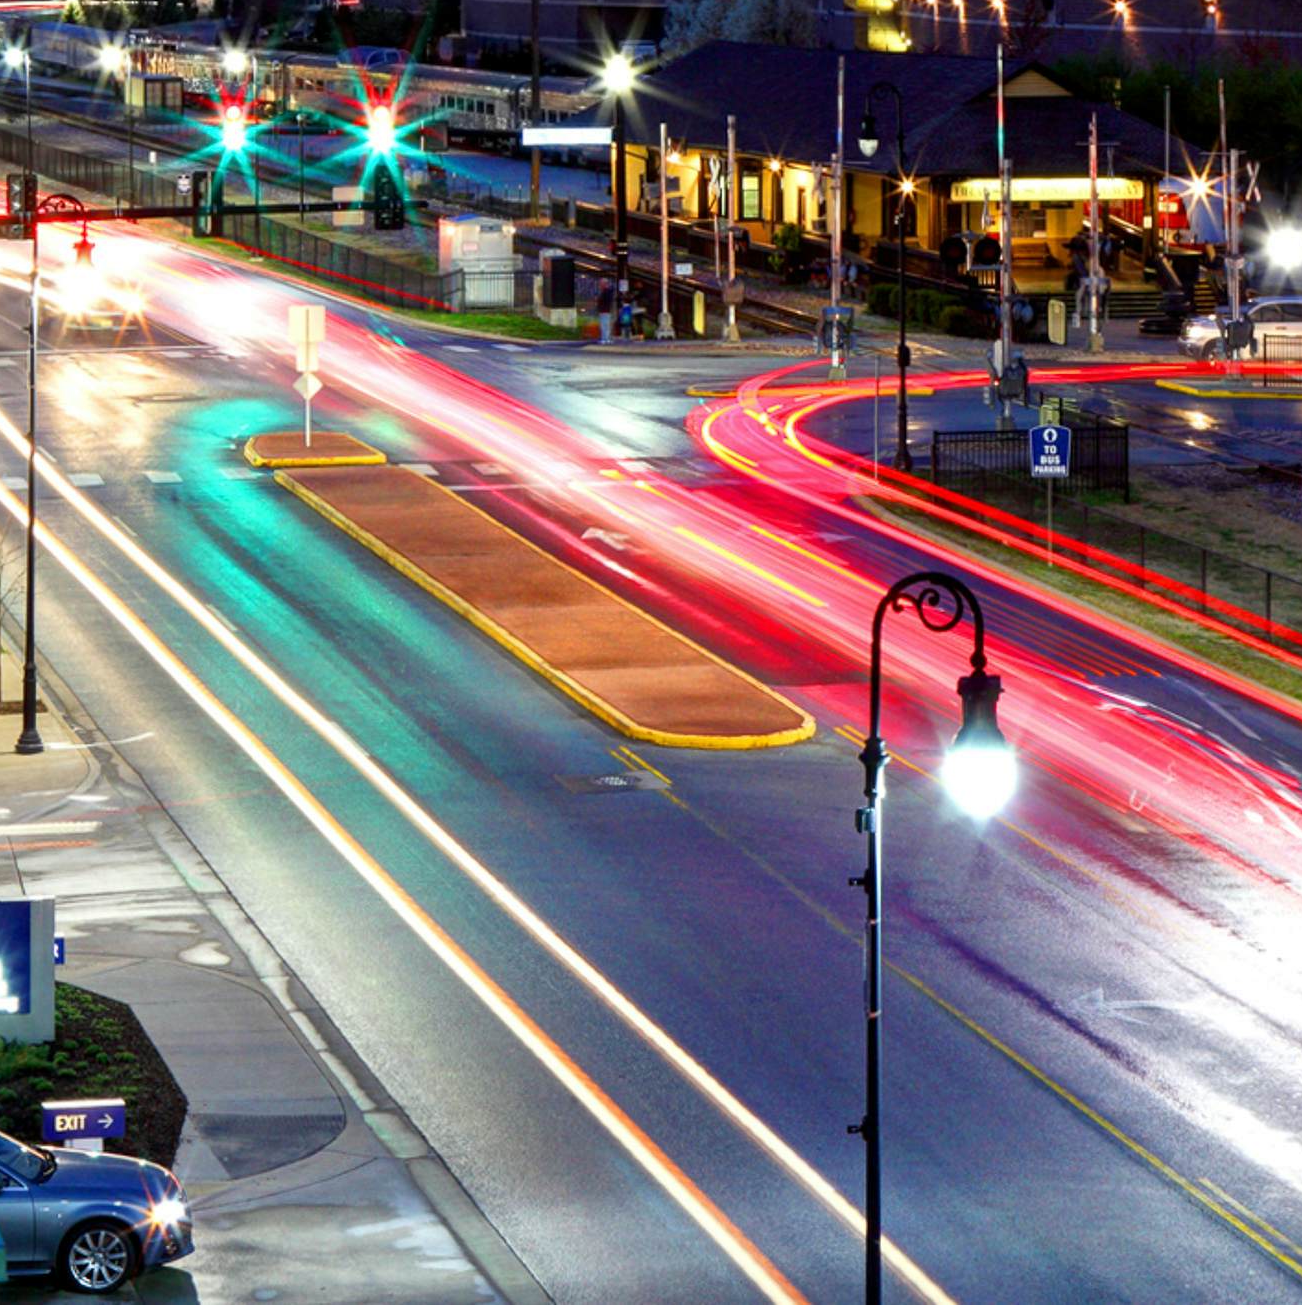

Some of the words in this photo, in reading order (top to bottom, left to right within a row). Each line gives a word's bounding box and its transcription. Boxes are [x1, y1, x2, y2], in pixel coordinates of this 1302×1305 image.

[1044, 445, 1057, 454] TO
[1040, 455, 1060, 465] BUS
[55, 1114, 87, 1132] EXIT
